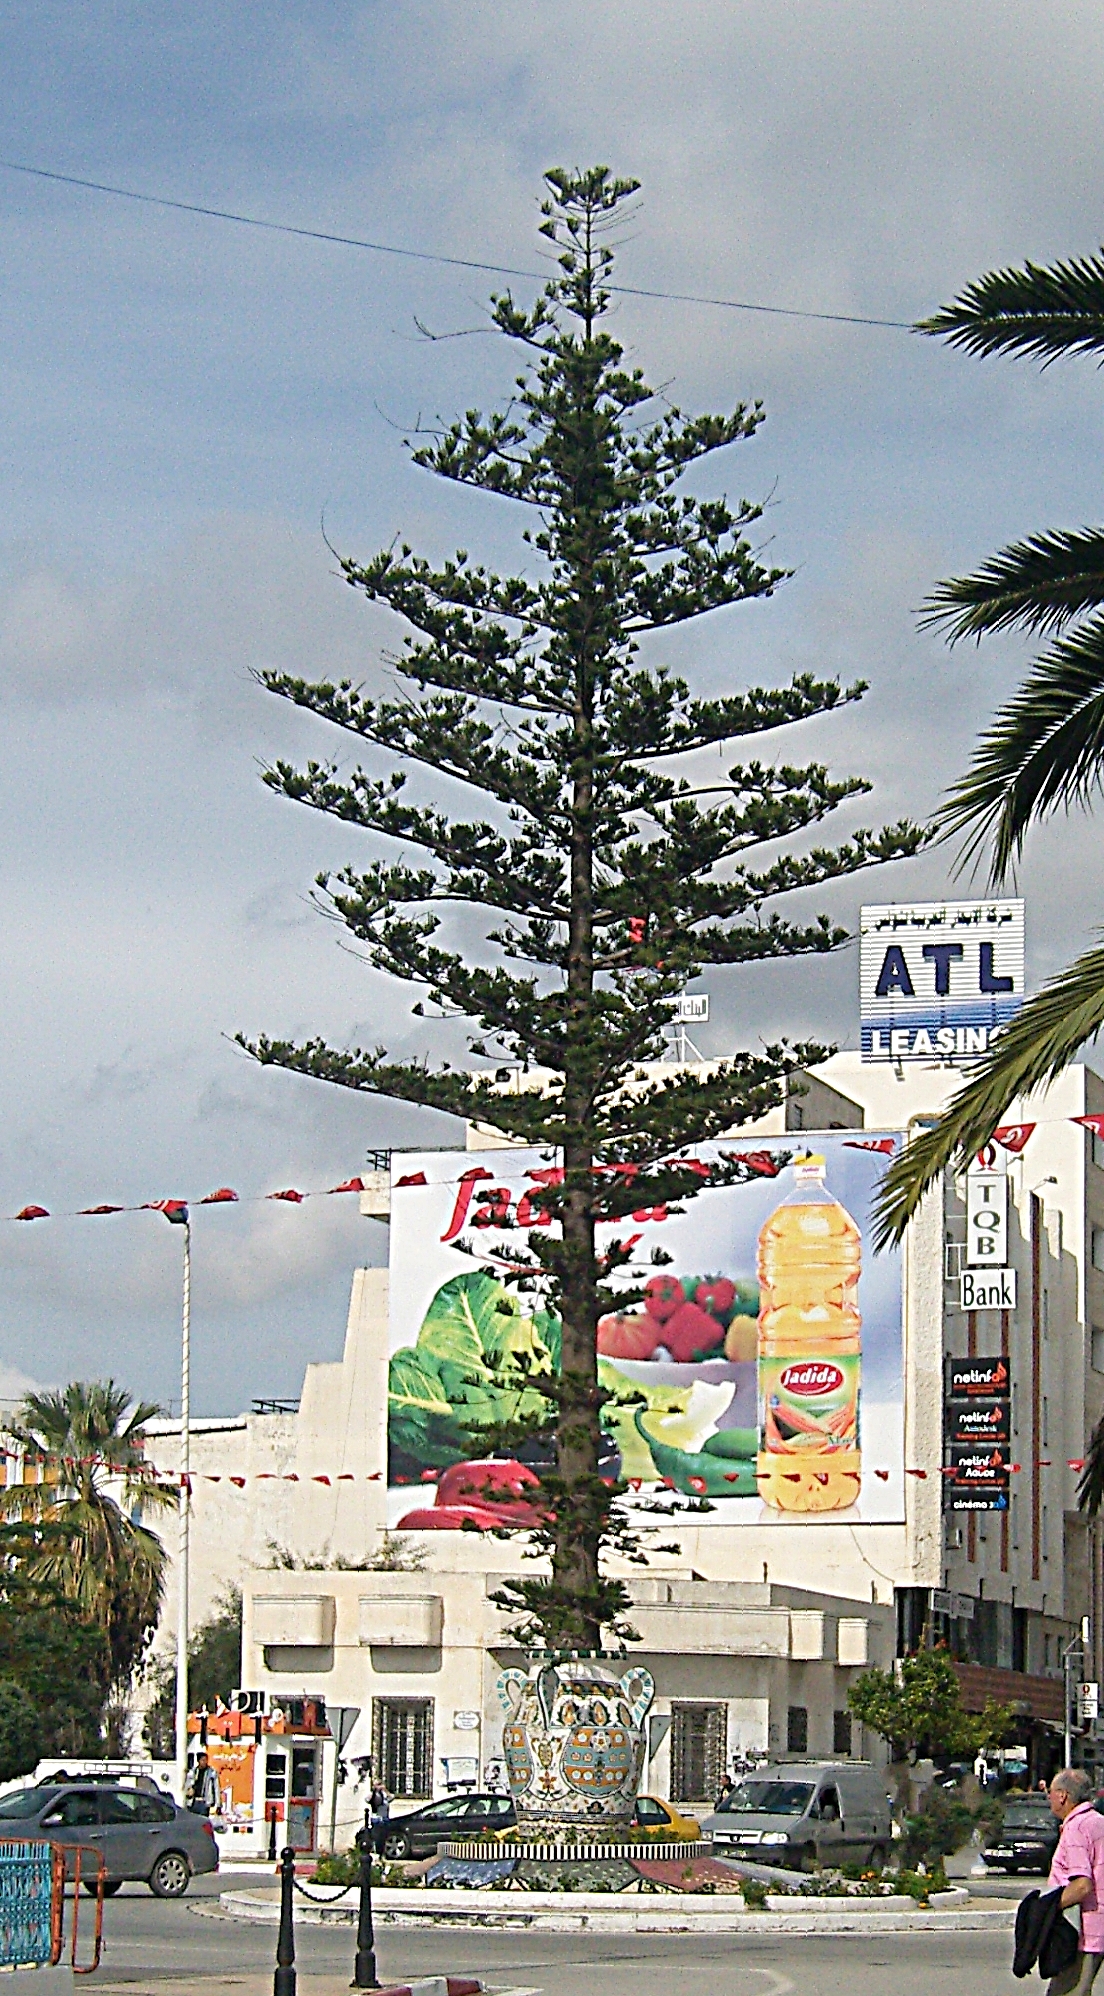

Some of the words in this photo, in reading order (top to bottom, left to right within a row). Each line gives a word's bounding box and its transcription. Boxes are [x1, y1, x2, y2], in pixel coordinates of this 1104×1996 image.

[875, 942, 1014, 996] ATL
[973, 1184, 1001, 1255] TQB
[963, 1272, 1013, 1307] Bank
[783, 1366, 837, 1386] Jadida
